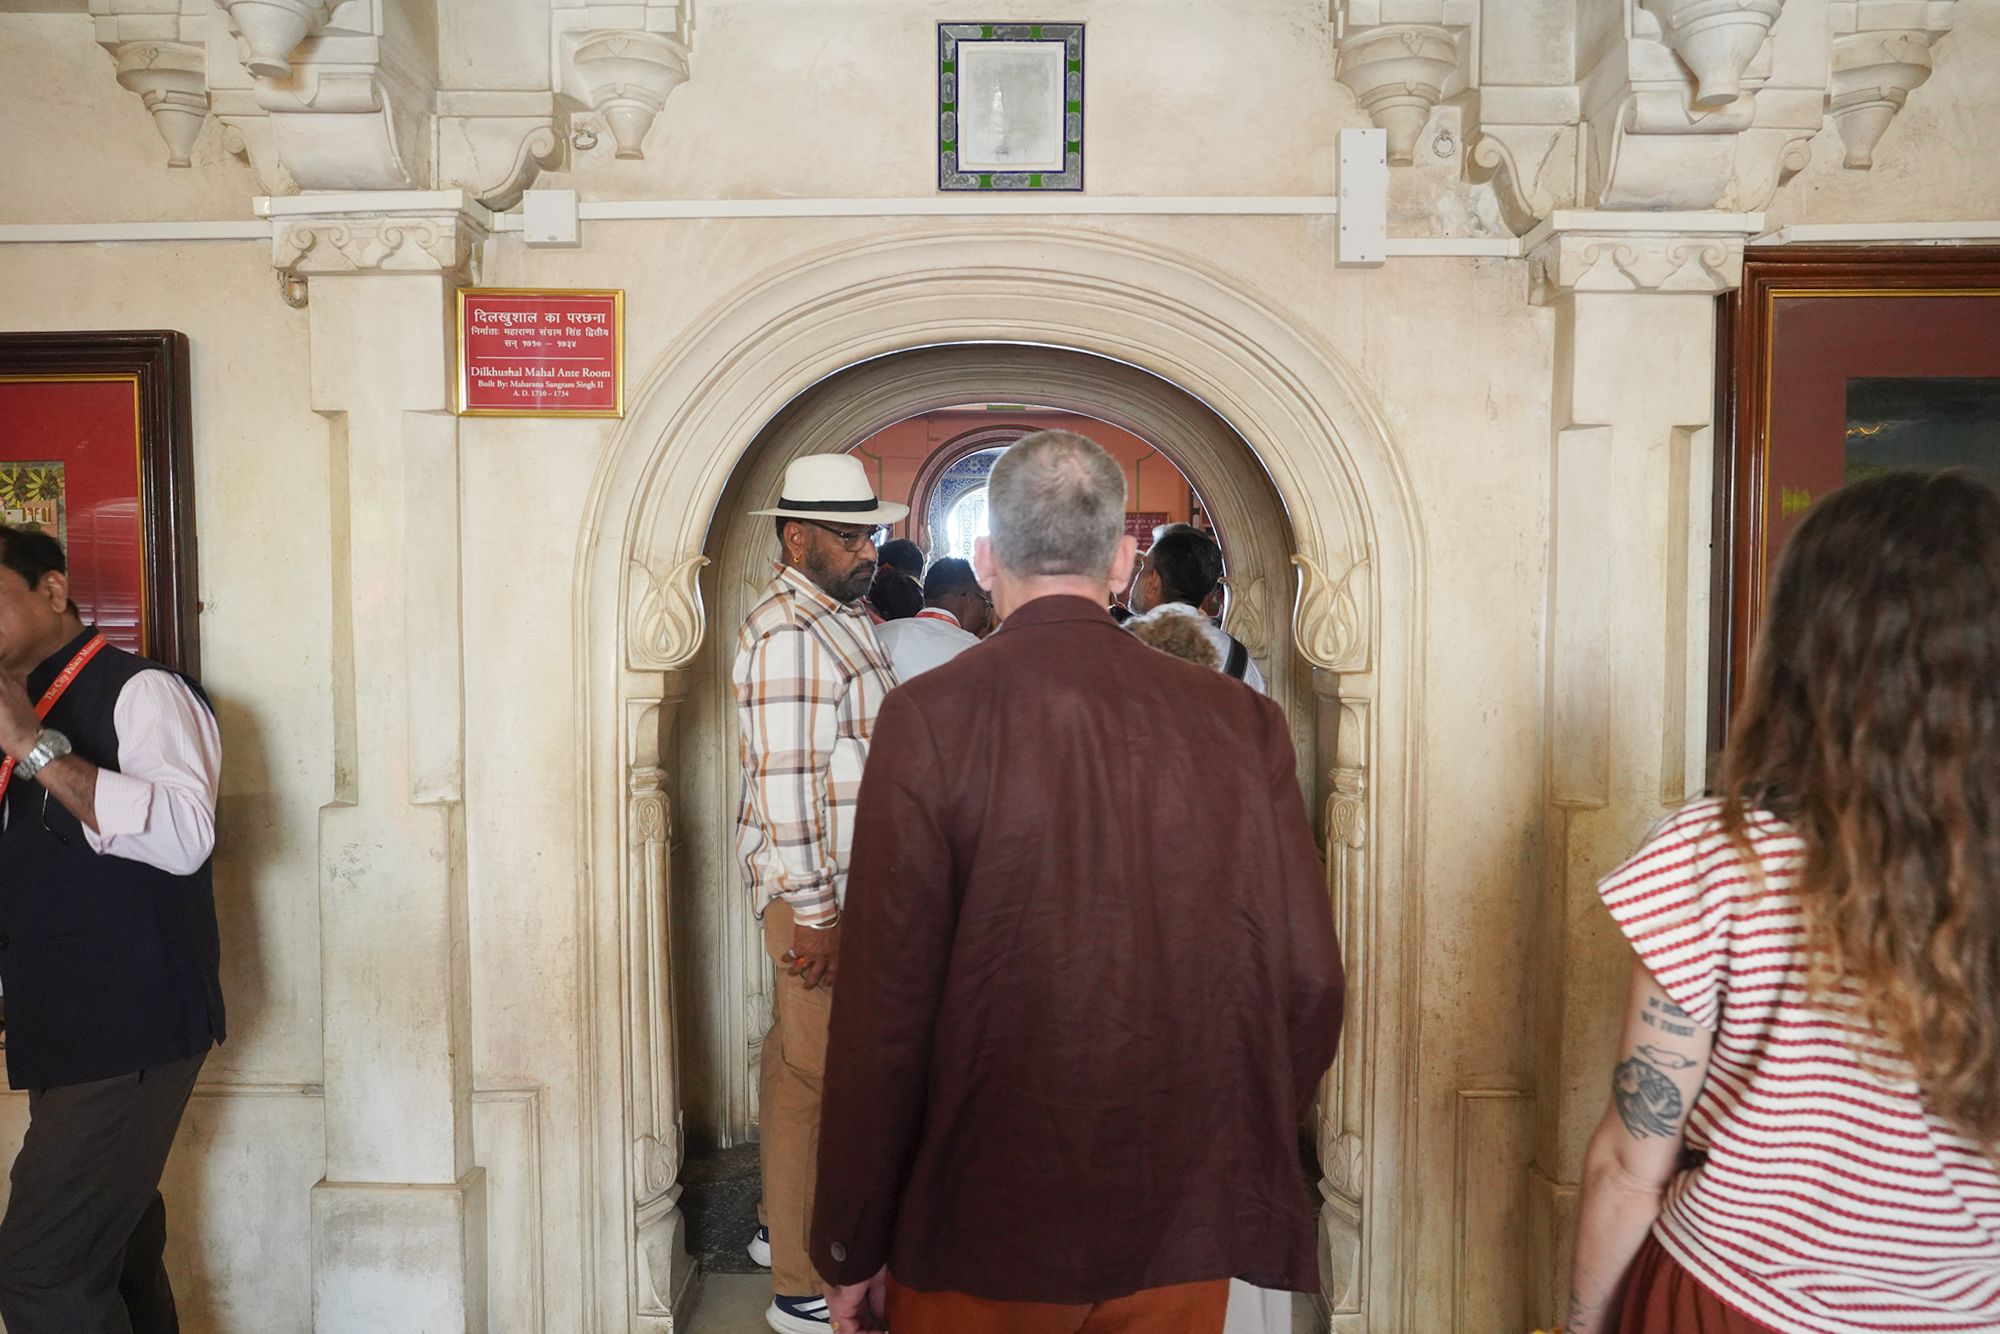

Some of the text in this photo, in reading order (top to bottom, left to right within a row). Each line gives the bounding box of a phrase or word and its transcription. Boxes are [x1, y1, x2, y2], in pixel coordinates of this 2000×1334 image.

[474, 308, 538, 326] दिलखुशाल
[544, 312, 561, 323] का
[504, 327, 535, 336] महाराणा
[539, 326, 562, 336] संग्राम
[565, 326, 582, 336] सिंह
[585, 327, 609, 337] द्वितीय
[504, 339, 518, 349] सन्
[522, 340, 541, 348] १७१०
[471, 366, 611, 377] Dilkhushal Mahal Ante Room
[478, 380, 495, 388] Built
[497, 380, 508, 389] By:
[510, 380, 544, 388] Maharana
[545, 381, 574, 390] Sangram
[576, 381, 596, 390] Singh
[46, 687, 58, 700] The
[54, 674, 69, 688] City
[63, 656, 84, 675] Palace
